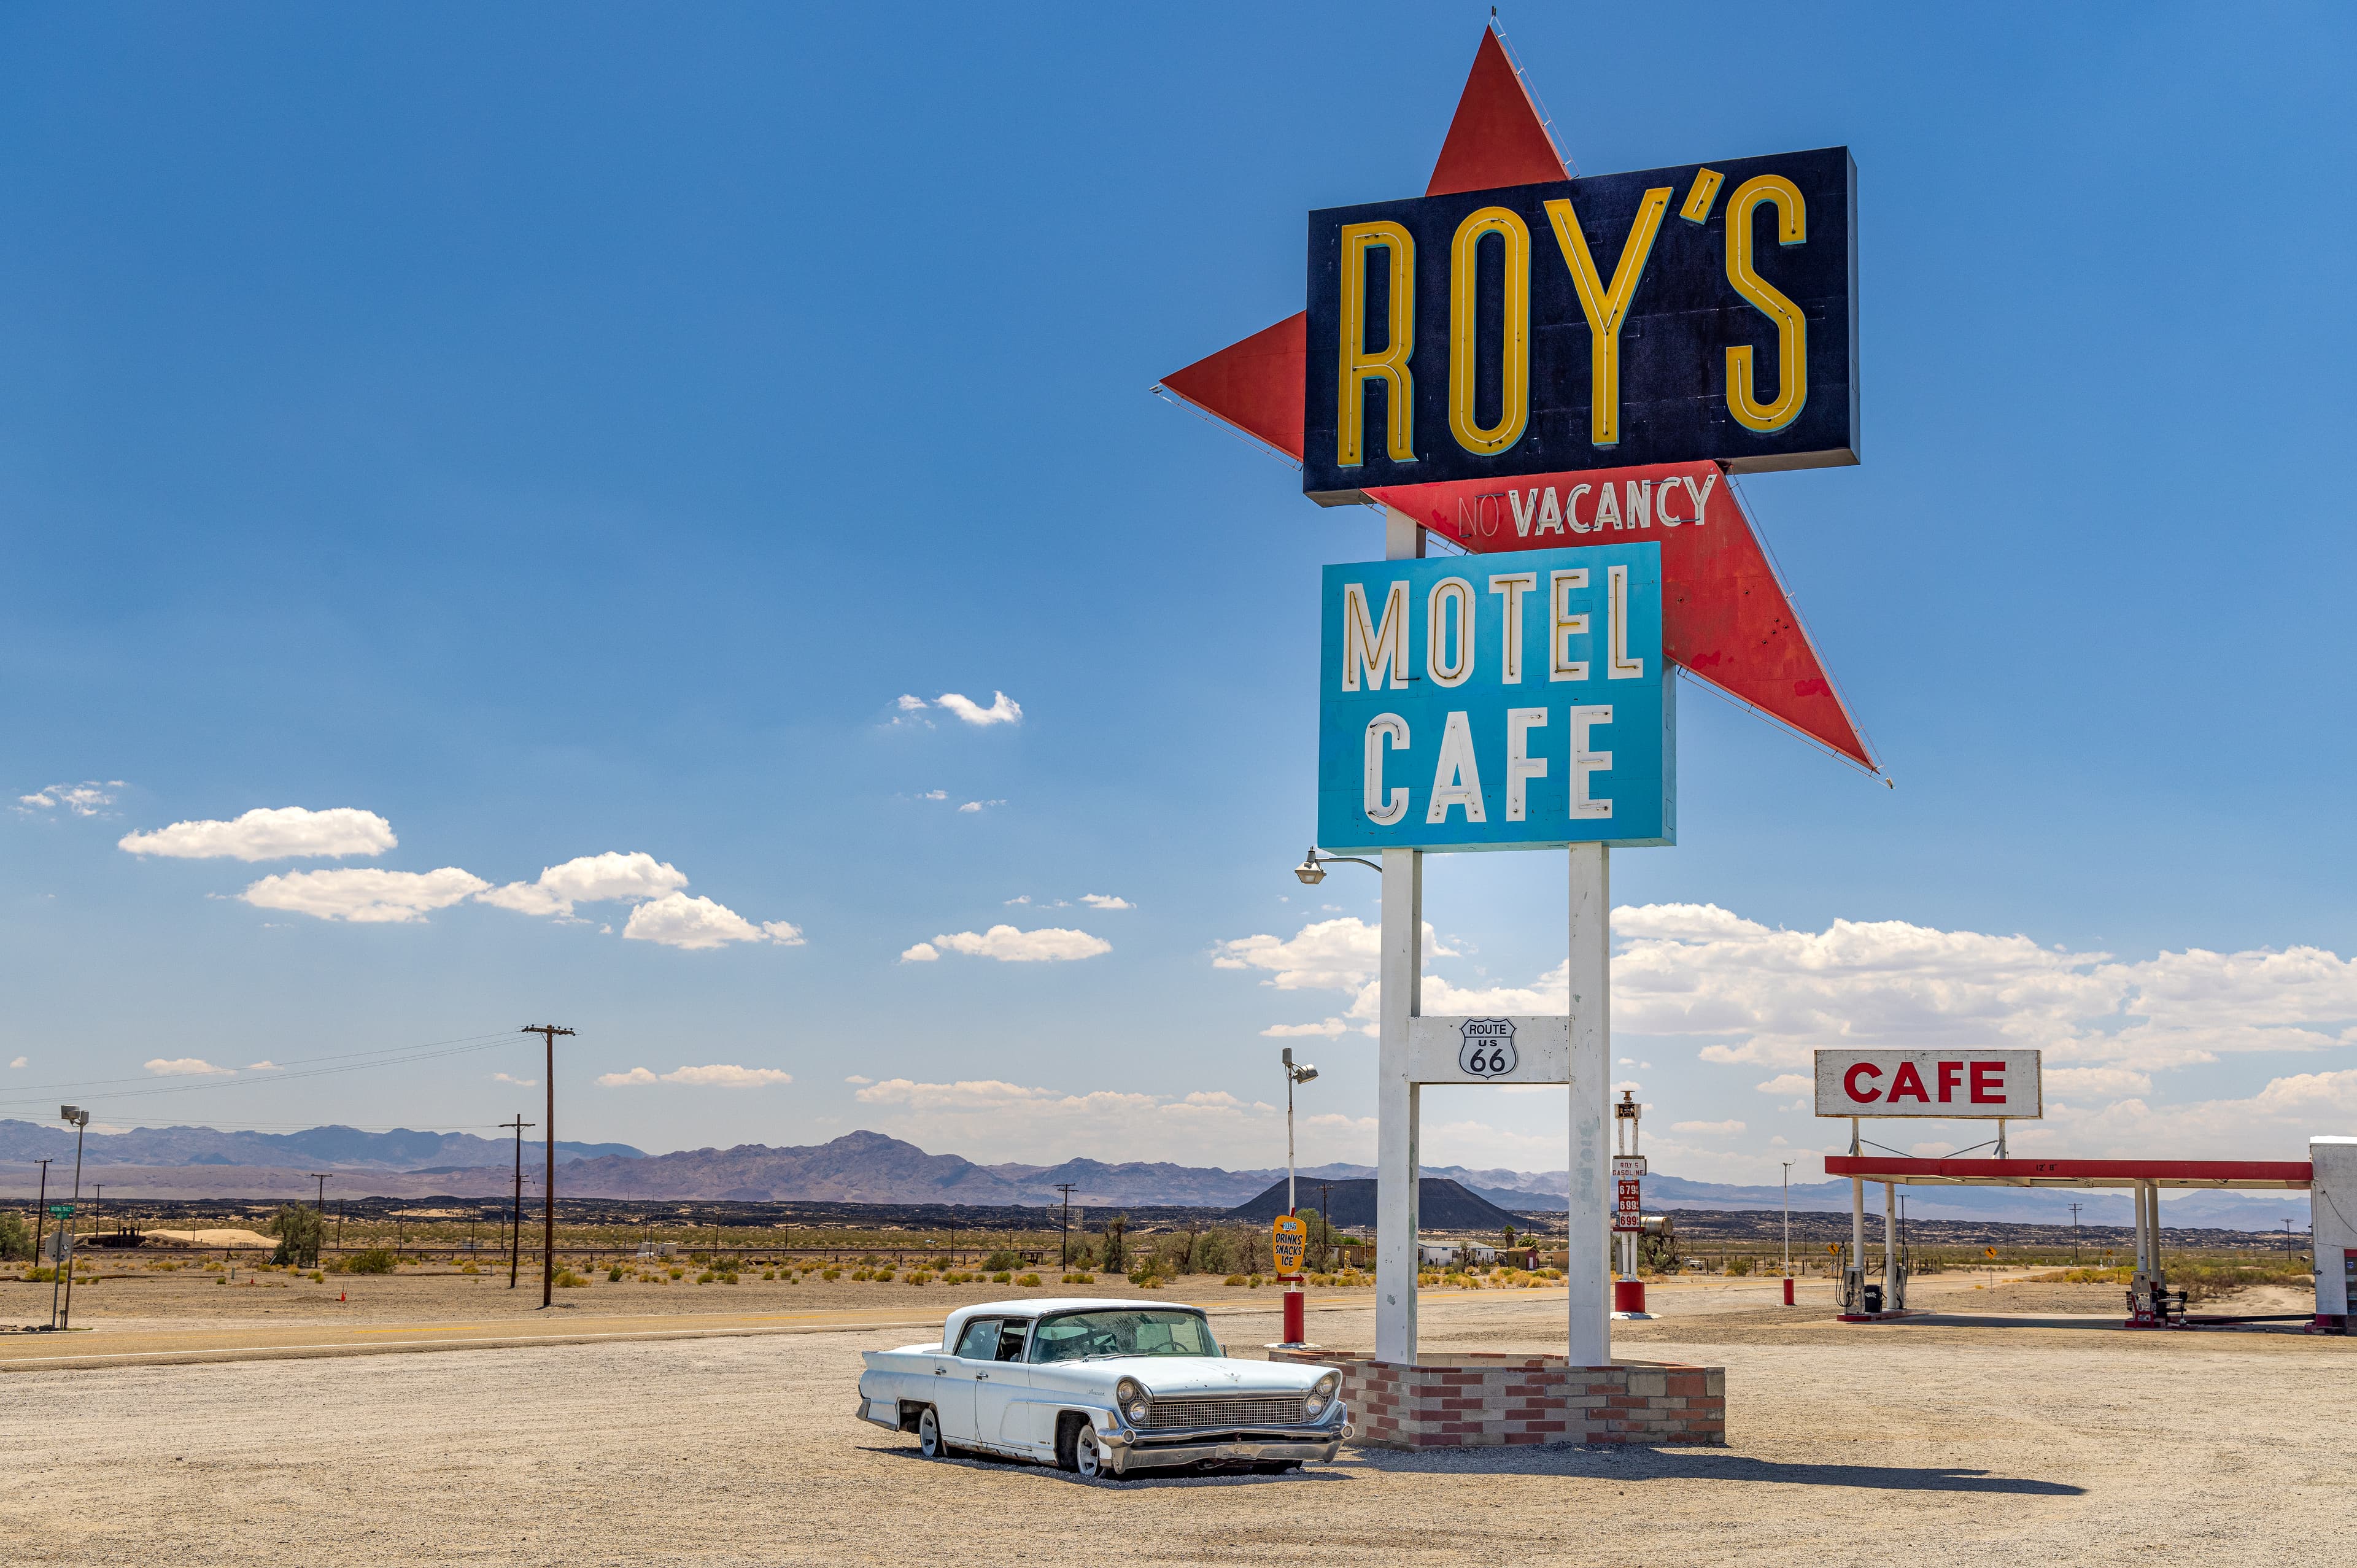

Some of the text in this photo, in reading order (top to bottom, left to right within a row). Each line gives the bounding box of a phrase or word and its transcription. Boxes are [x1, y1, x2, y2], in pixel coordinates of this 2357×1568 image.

[1337, 168, 1806, 468] ROY'S
[1458, 474, 1717, 538] NO VACANCY
[1342, 565, 1643, 692] MOTEL
[1364, 705, 1612, 825] CAFE
[1469, 1024, 1506, 1035] ROUTE
[1470, 1048, 1506, 1072] 66
[1843, 1061, 2007, 1103] CAFE
[1275, 1233, 1302, 1245] DRINKS
[1275, 1245, 1302, 1255] SNACKS
[1282, 1256, 1293, 1266] ICE
